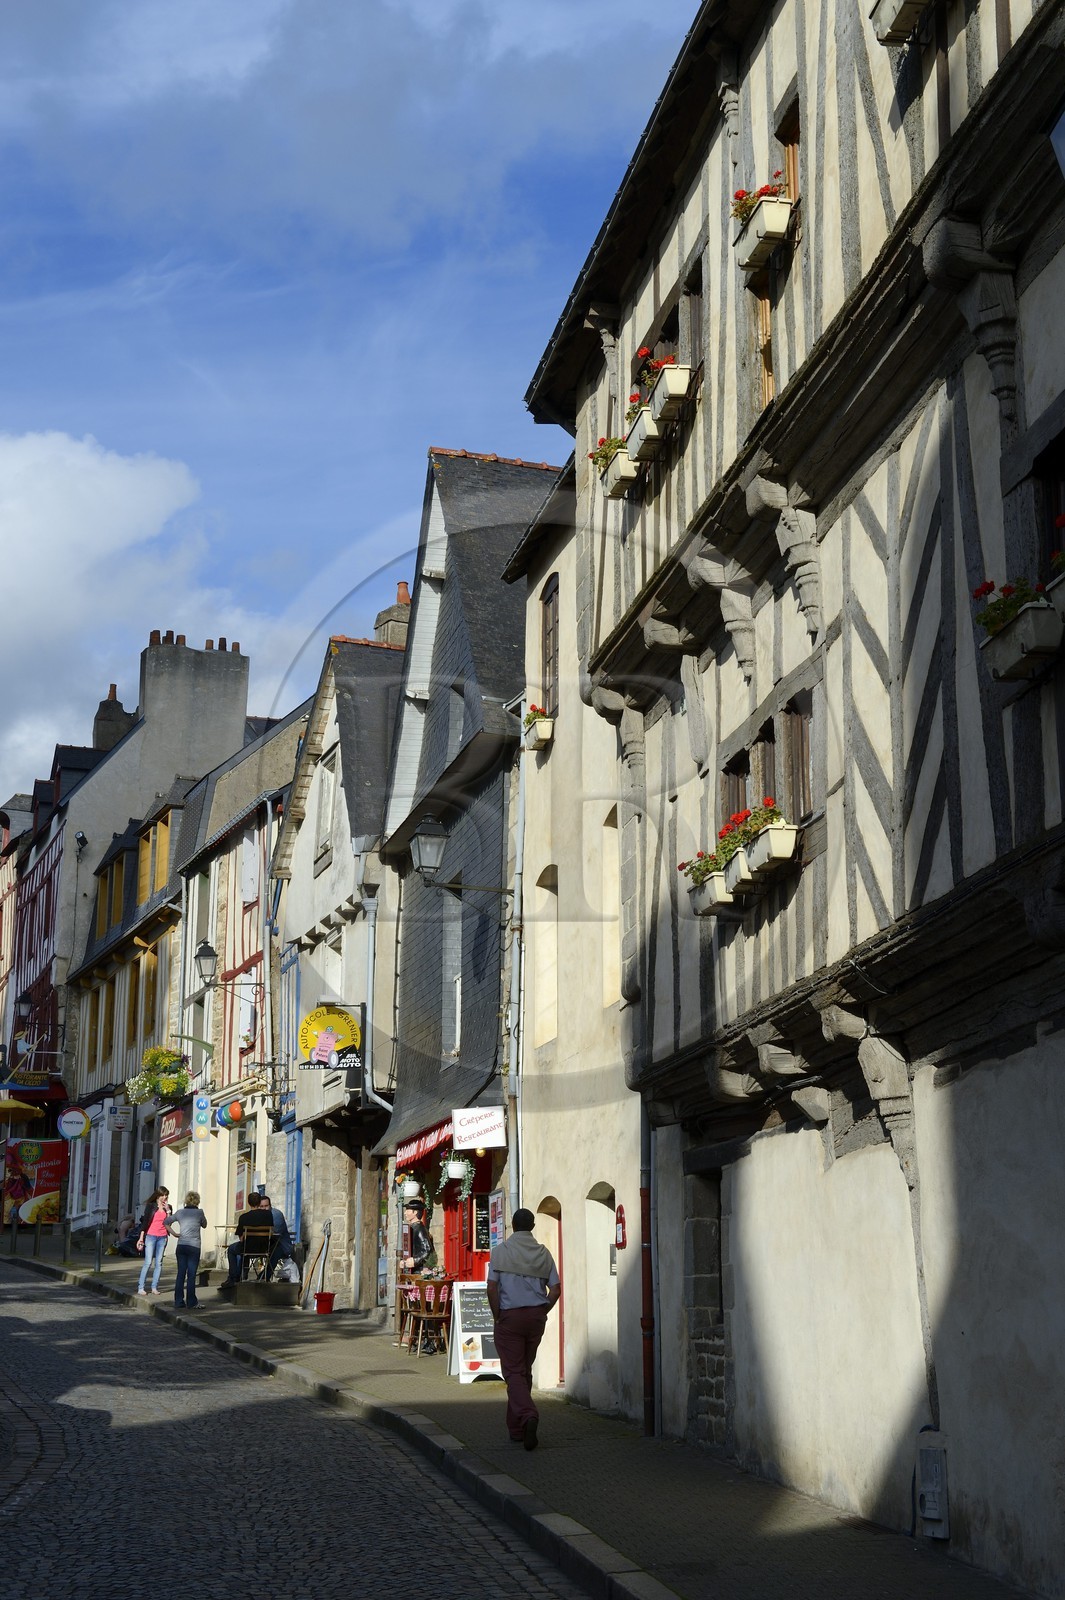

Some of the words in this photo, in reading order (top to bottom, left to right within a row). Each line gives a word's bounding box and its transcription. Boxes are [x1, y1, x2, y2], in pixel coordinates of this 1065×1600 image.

[337, 1011, 358, 1043] GRENIER
[458, 1110, 495, 1128] Crêperie
[455, 1121, 504, 1145] Restaurant
[144, 1161, 151, 1169] P
